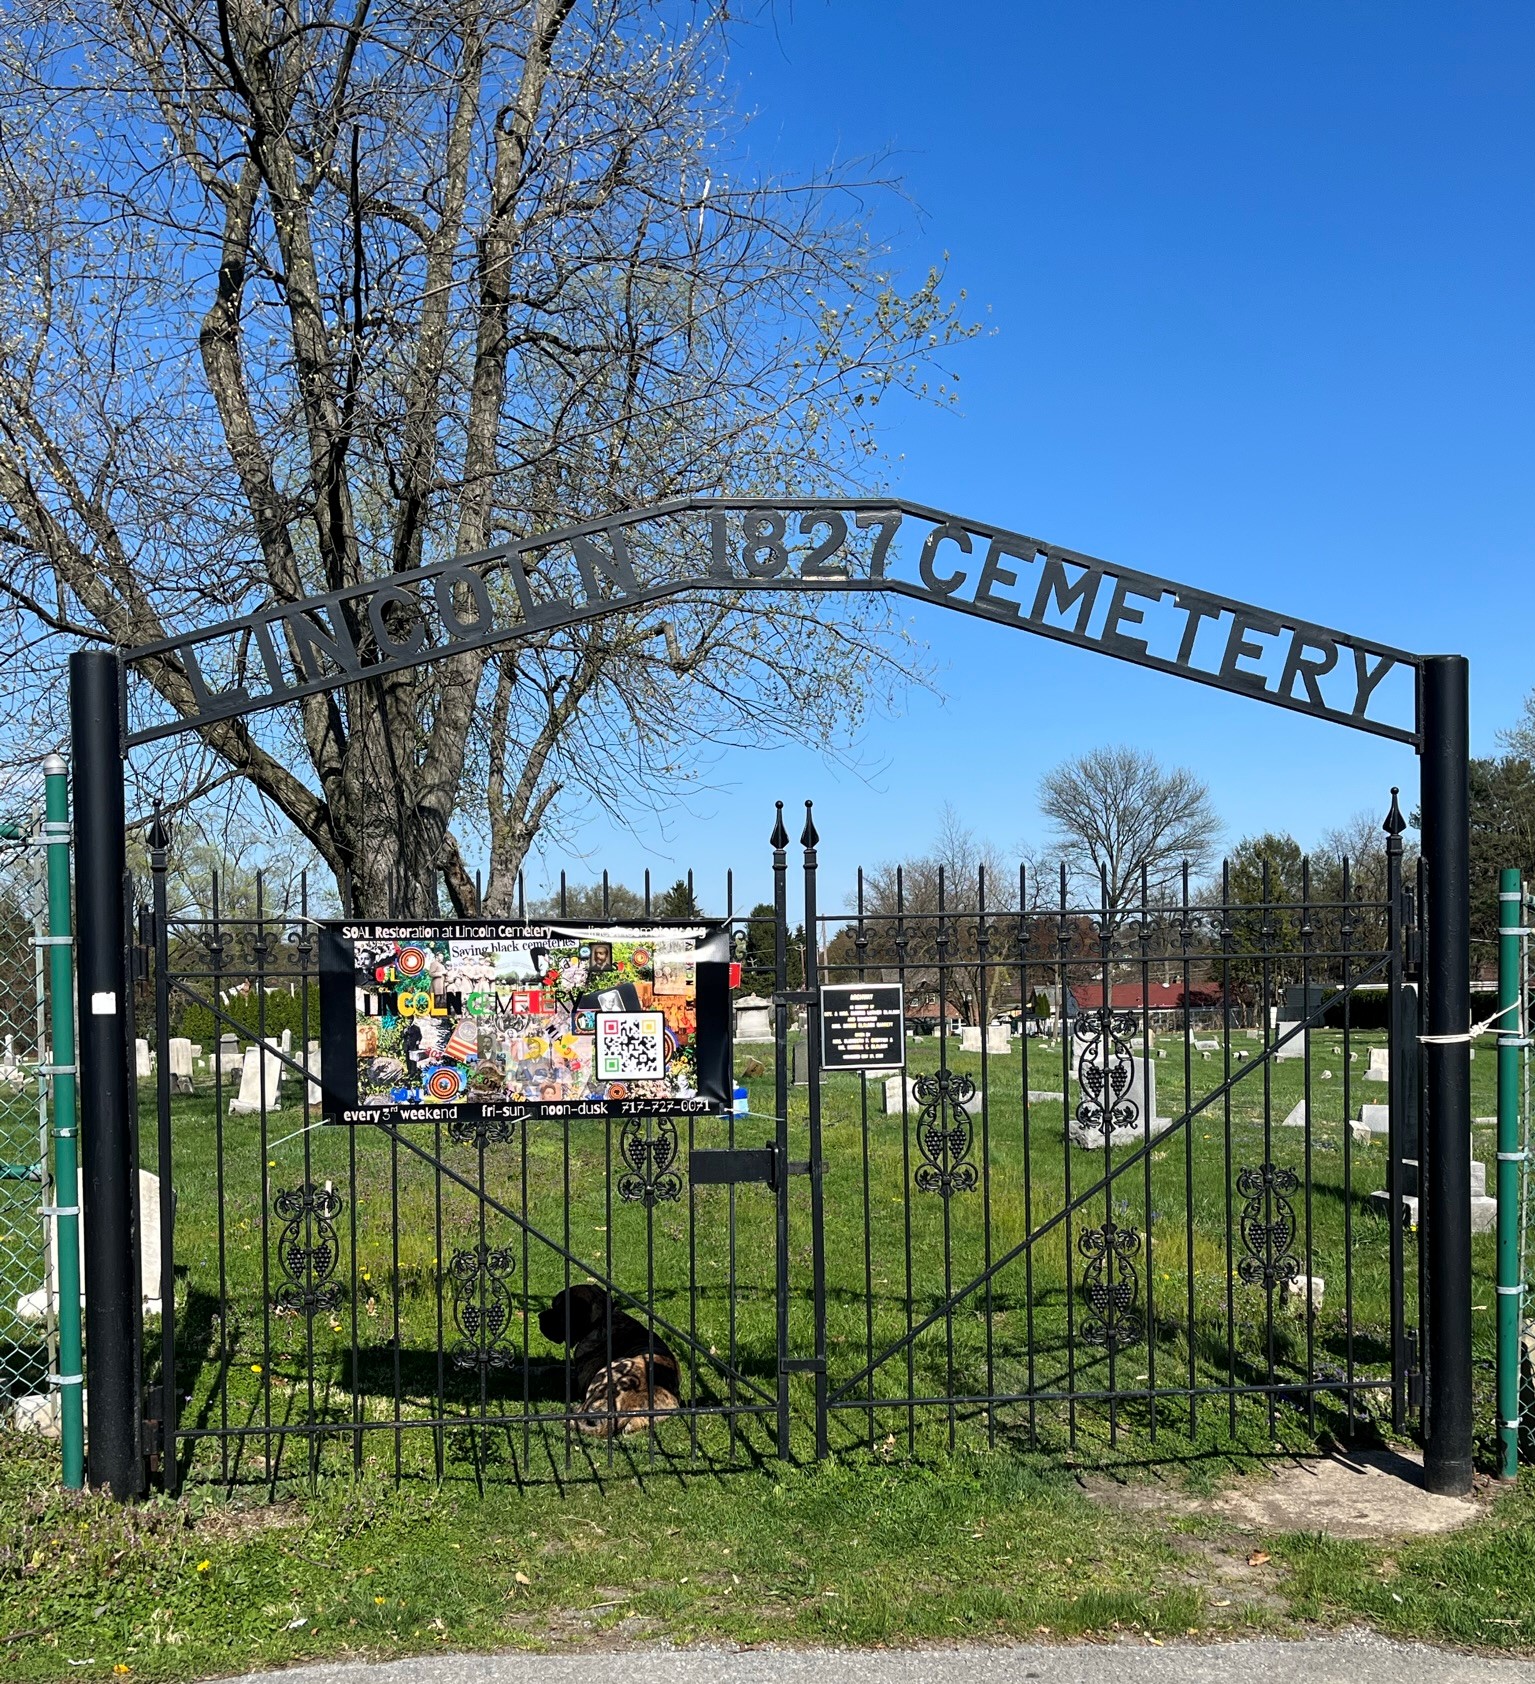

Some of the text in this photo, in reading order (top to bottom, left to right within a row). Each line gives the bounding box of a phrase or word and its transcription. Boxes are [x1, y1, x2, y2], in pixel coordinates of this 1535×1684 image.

[709, 508, 902, 581] 1827
[180, 524, 640, 708] LINCOLN
[919, 522, 1397, 720] CEMETERY
[342, 924, 553, 940] SOAL Restoration at Lincoln Cemetery
[452, 939, 576, 958] Saving black cemeteries
[467, 989, 584, 1015] CEMETERY
[343, 1109, 381, 1123] every
[400, 1105, 458, 1120] weekend
[482, 1104, 525, 1118] fri-sun
[540, 1101, 608, 1115] noon-dusk
[621, 1099, 711, 1114] 717-727-0071
